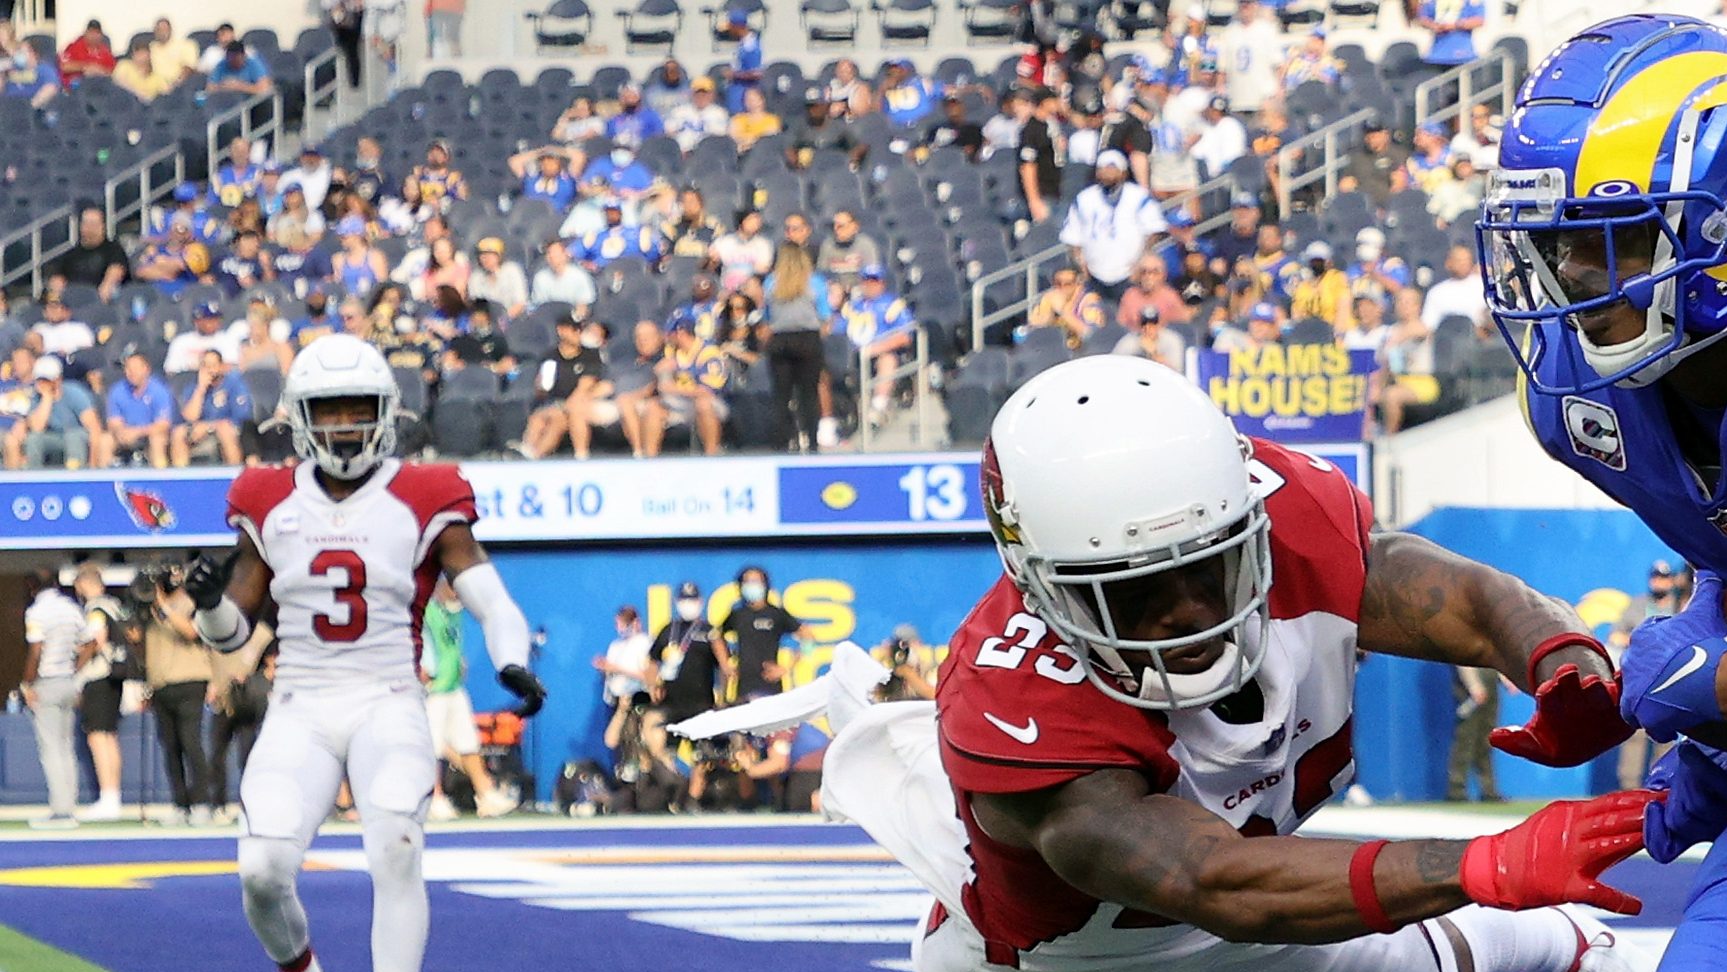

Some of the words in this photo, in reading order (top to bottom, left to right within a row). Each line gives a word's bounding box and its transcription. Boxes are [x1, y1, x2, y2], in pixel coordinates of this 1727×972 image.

[1209, 374, 1367, 417] HOUSE!
[518, 484, 544, 518] &
[561, 482, 604, 518] 10
[723, 486, 754, 514] 14
[899, 464, 967, 521] 13
[309, 549, 369, 643] 3
